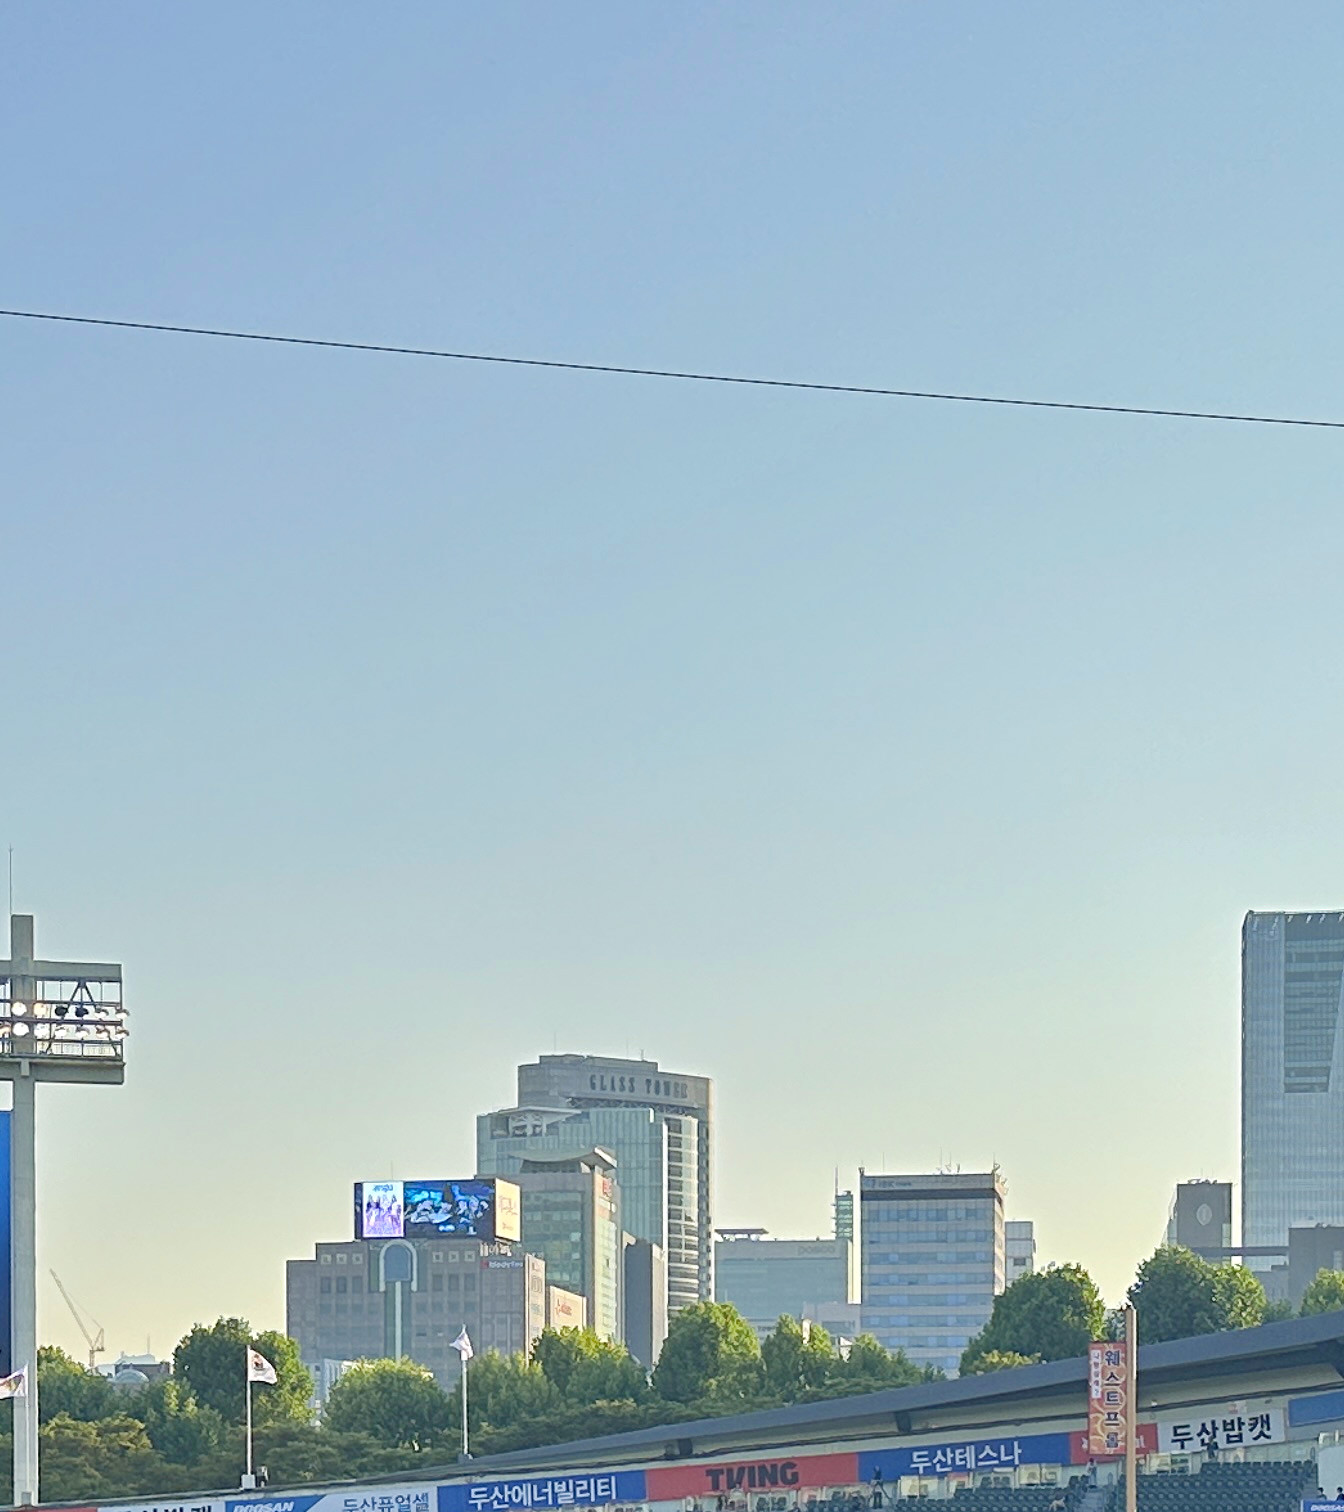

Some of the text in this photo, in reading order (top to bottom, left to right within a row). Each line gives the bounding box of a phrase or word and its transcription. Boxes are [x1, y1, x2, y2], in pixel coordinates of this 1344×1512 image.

[590, 1075, 635, 1092] GLASS
[1171, 1413, 1272, 1449] 두산밥캣
[705, 1461, 798, 1490] TVING
[909, 1440, 1022, 1476] 두산테스나
[468, 1475, 617, 1510] 두산에너빌리티
